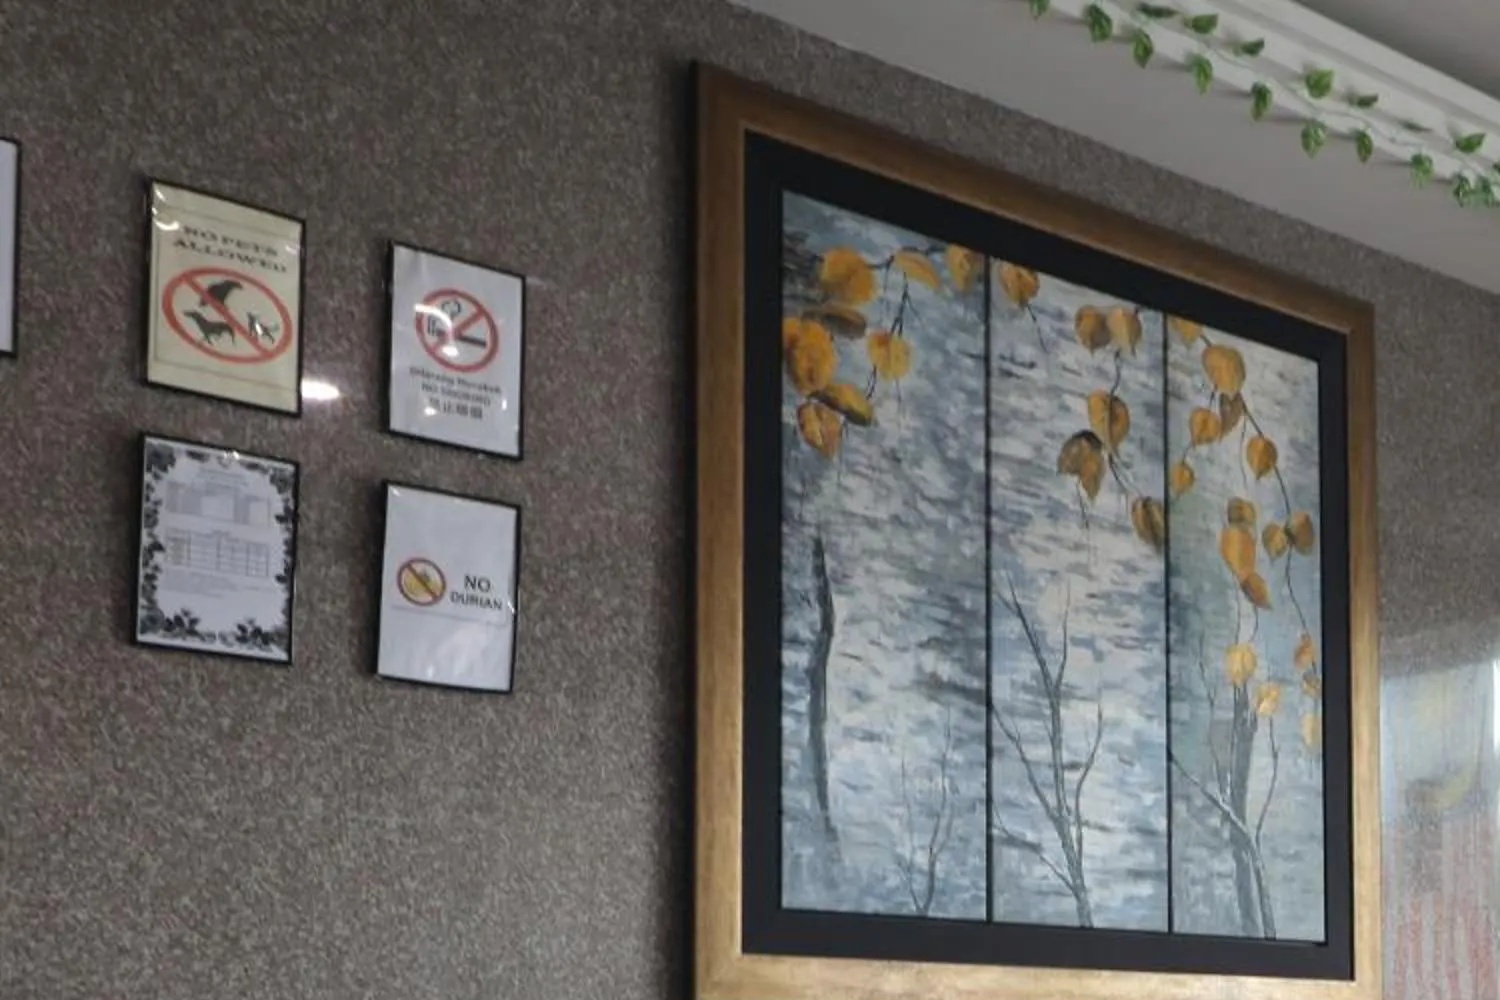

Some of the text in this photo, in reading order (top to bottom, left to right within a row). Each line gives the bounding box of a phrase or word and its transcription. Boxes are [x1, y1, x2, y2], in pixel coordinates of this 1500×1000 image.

[183, 225, 278, 257] NO PETS
[173, 239, 287, 273] ALLOWED
[464, 575, 491, 593] NO
[450, 591, 502, 610] DURIAN
